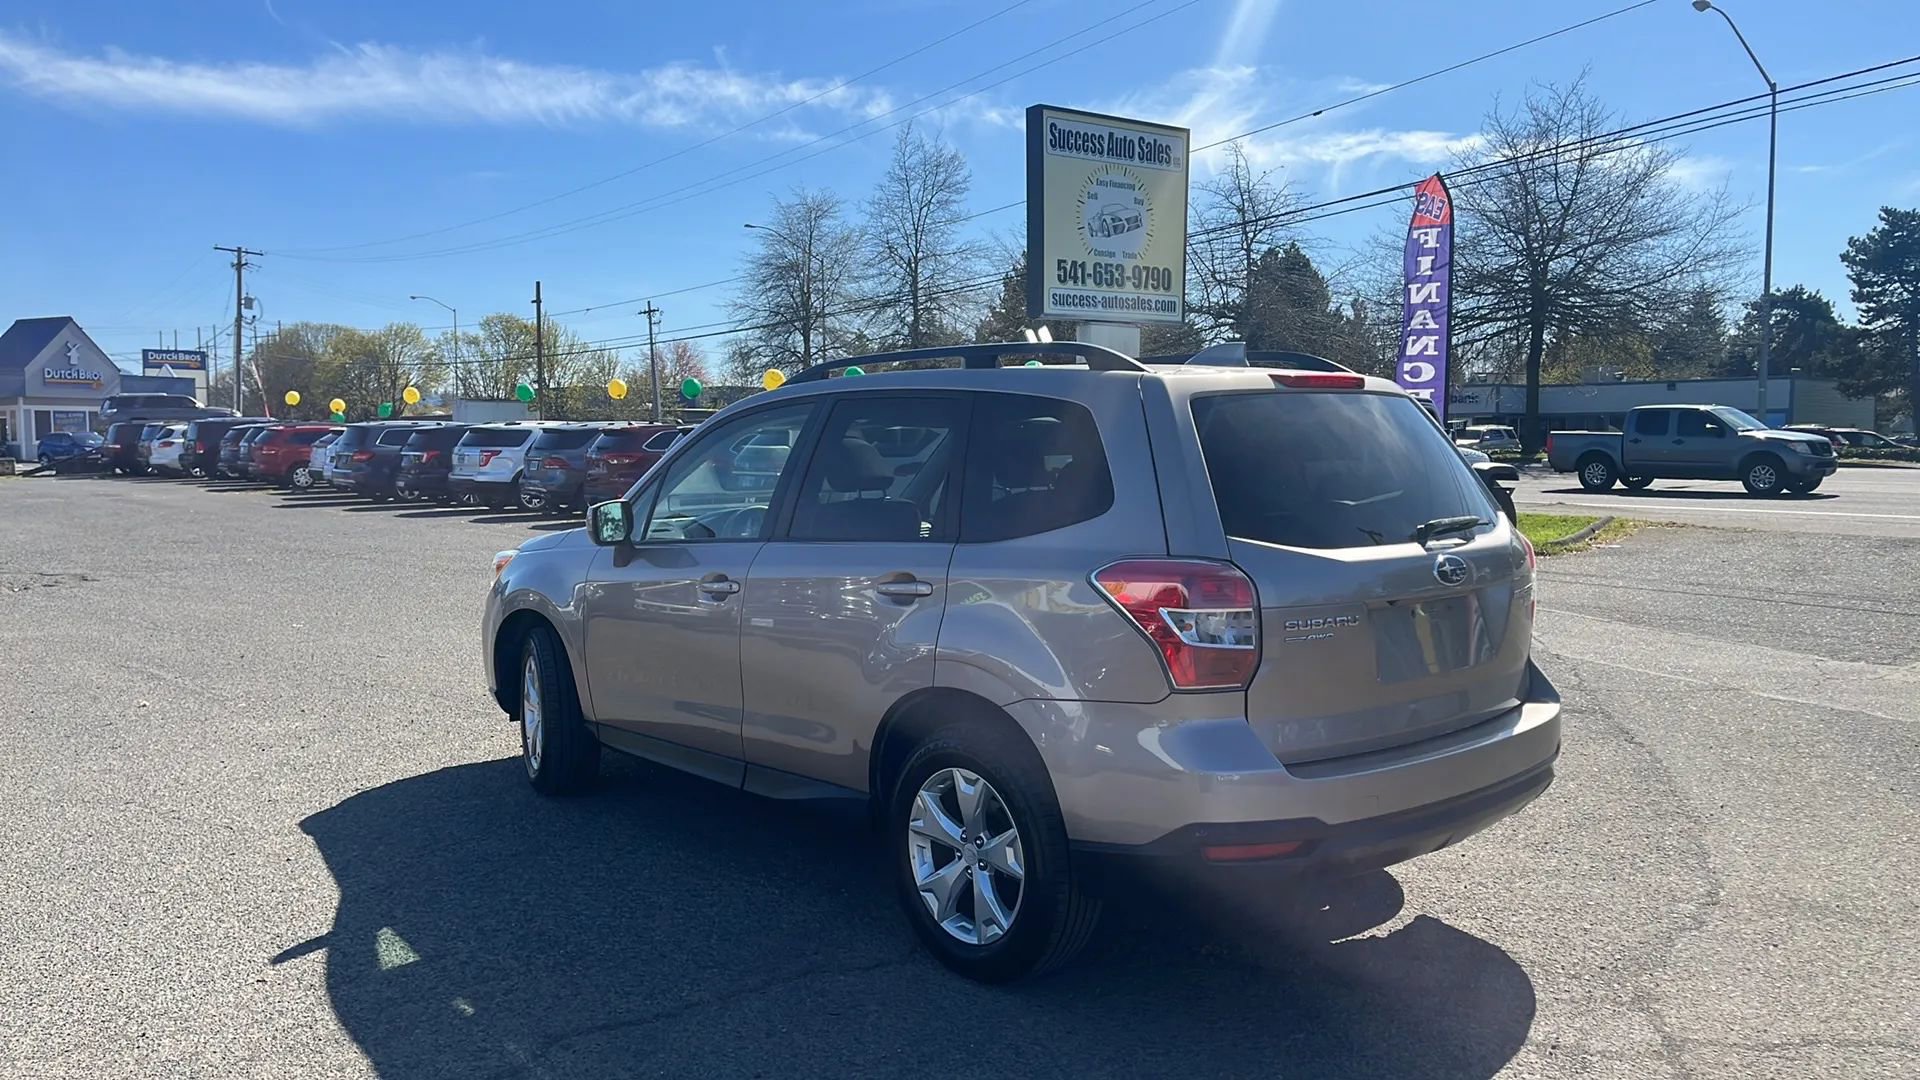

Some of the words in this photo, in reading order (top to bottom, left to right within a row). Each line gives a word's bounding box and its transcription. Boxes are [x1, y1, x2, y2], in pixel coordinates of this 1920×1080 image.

[1049, 122, 1104, 158] Success
[1107, 132, 1135, 160] Auto
[1138, 136, 1172, 166] Sales
[1057, 258, 1172, 292] 541-653-9790
[1052, 292, 1177, 314] success-autosales.com
[148, 351, 178, 361] DUTCH
[178, 352, 201, 361] BROS
[44, 367, 78, 379] DUTCH
[1285, 616, 1359, 631] SUBARU
